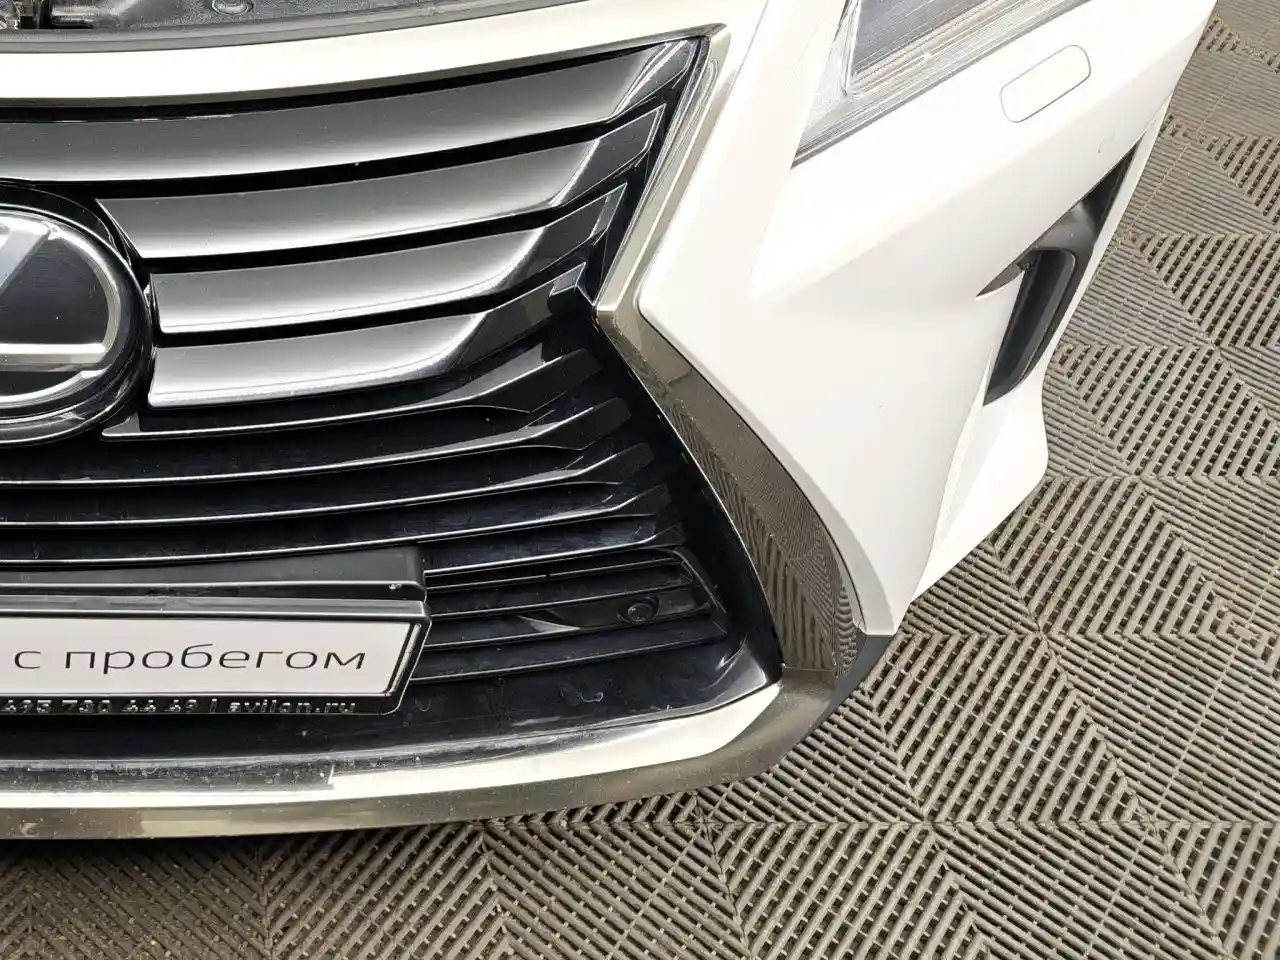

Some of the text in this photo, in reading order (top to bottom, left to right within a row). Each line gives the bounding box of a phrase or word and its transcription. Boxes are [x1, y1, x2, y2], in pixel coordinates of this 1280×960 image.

[13, 649, 42, 670] с
[64, 642, 367, 675] пробегом
[0, 698, 52, 714] 495
[61, 698, 113, 714] 730
[227, 698, 357, 714] avilon.ru
